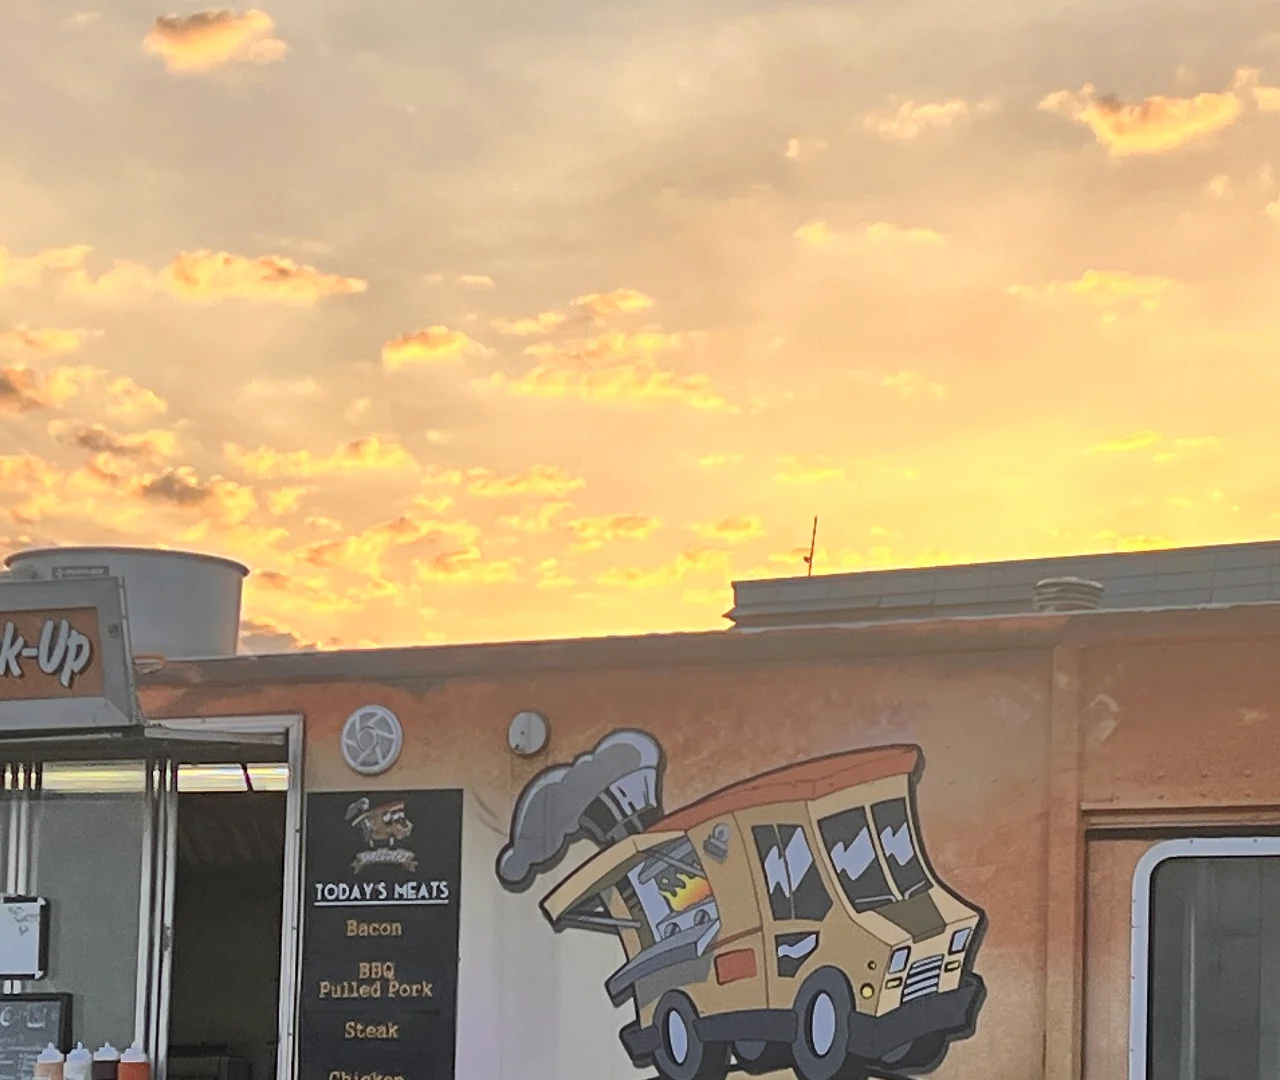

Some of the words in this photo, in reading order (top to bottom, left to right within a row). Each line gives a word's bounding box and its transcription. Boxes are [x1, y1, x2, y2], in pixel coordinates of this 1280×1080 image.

[315, 882, 387, 900] TODAY'S
[393, 881, 449, 899] MEATS
[346, 919, 402, 936] Bacon
[359, 962, 395, 979] BBQ
[319, 981, 381, 998] Pulled
[387, 980, 433, 998] Pork
[345, 1021, 399, 1038] Steak
